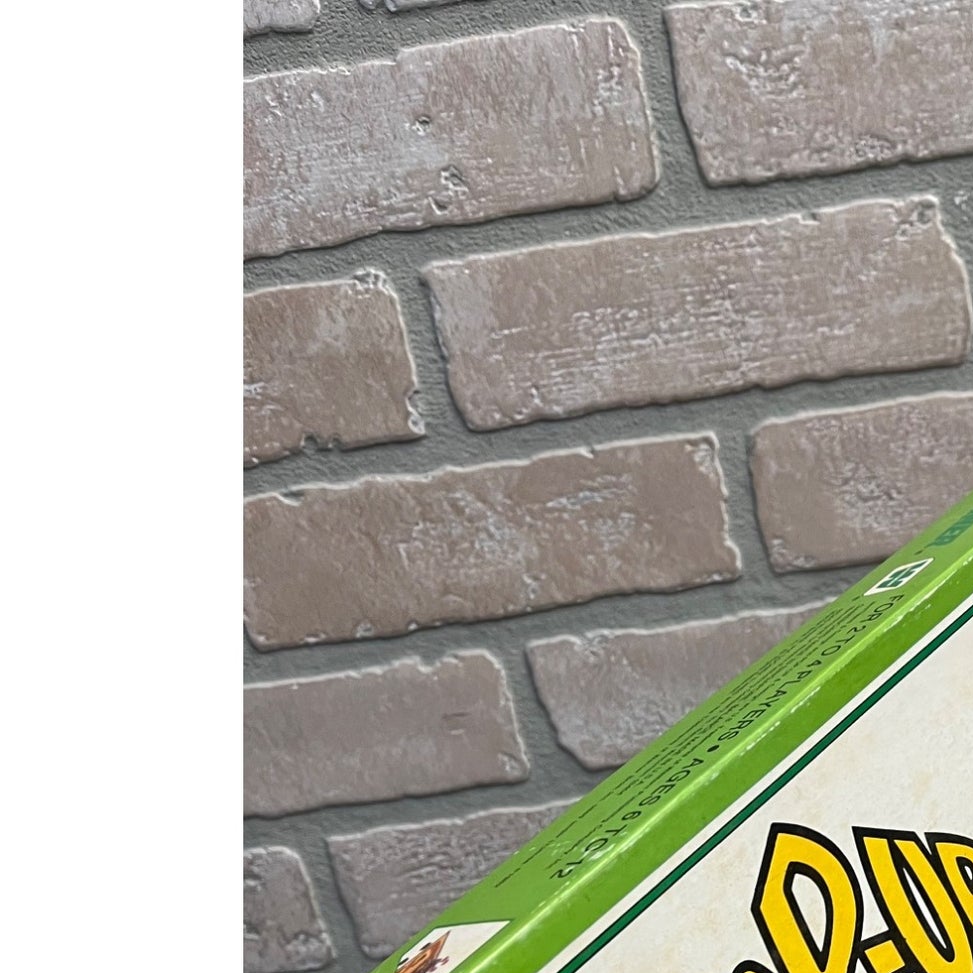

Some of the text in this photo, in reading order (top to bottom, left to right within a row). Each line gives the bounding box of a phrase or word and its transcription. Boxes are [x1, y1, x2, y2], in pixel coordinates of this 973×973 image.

[863, 594, 904, 623] FOR
[847, 625, 867, 635] 2
[821, 634, 855, 657] TO
[717, 669, 814, 741] PLAYERS
[639, 758, 704, 807] AGES
